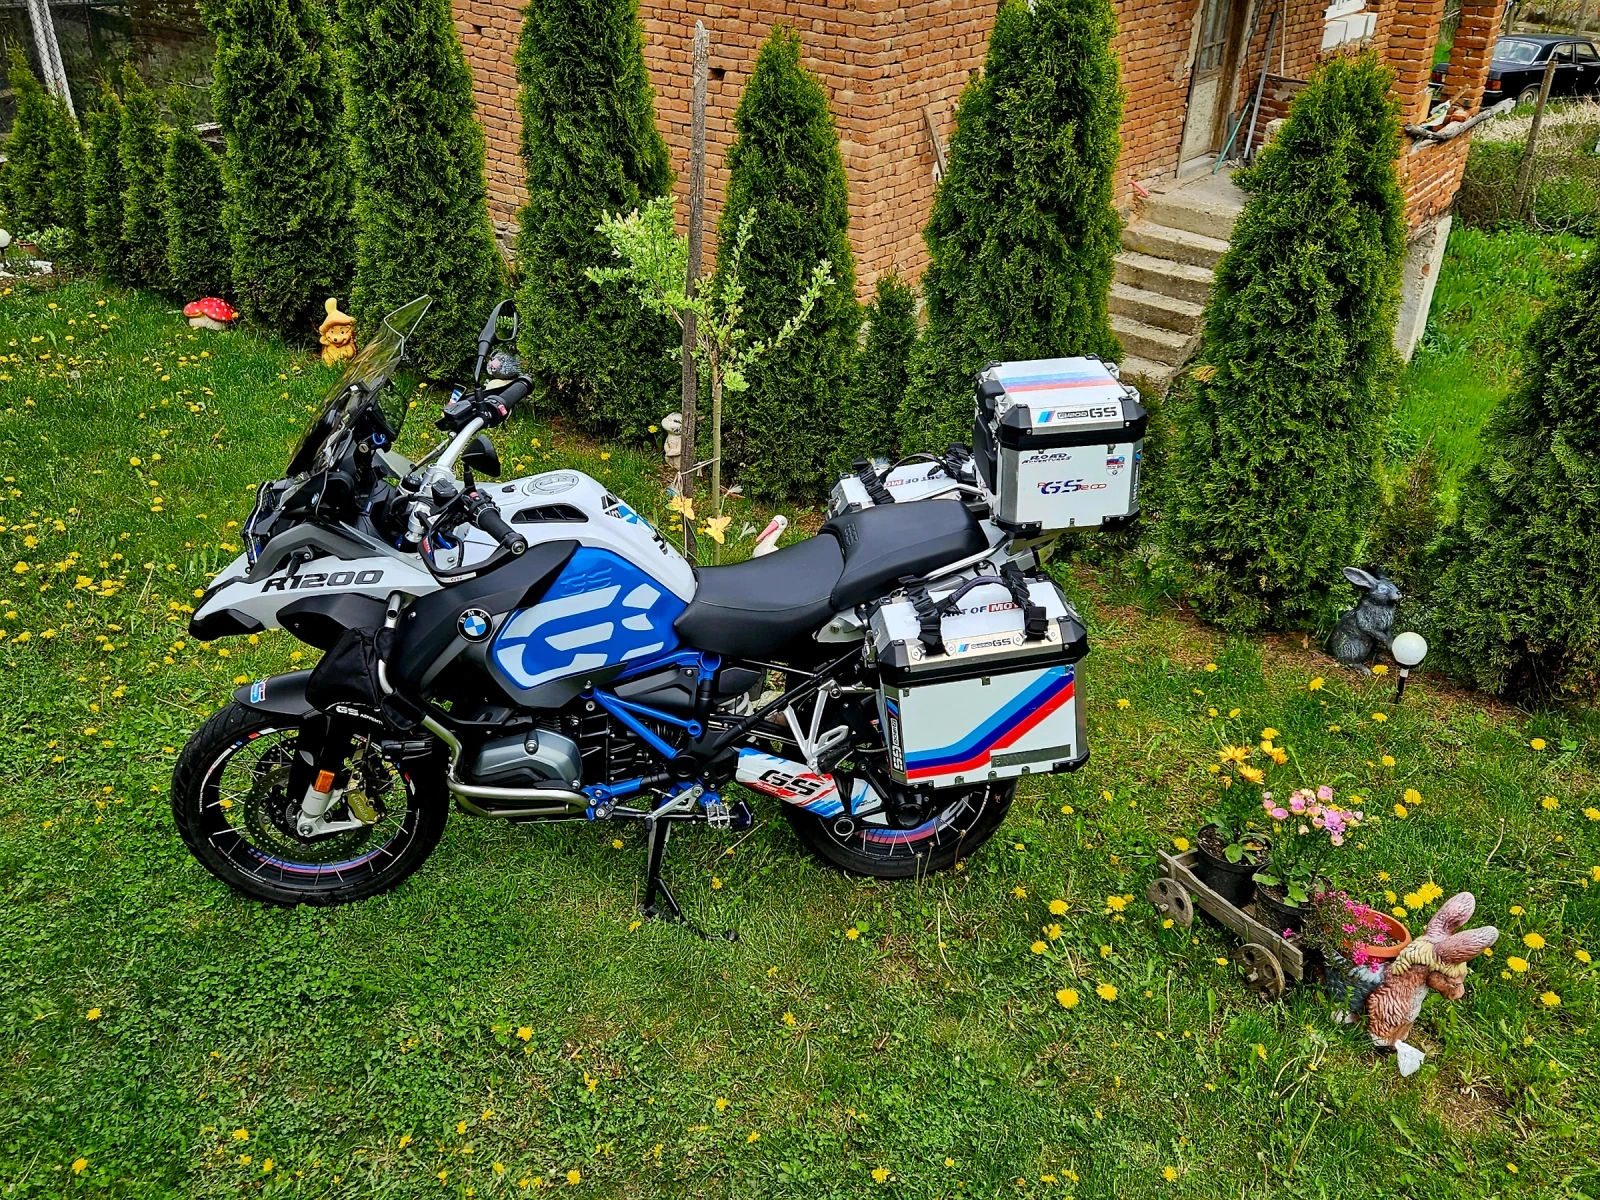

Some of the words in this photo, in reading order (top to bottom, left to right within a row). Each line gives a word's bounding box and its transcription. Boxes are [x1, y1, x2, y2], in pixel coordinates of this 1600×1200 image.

[1089, 406, 1118, 418] GS
[1030, 453, 1068, 461] ROAD
[260, 570, 384, 593] R1200
[560, 567, 612, 597] GS
[970, 605, 988, 614] OF
[459, 610, 487, 624] BMW
[993, 638, 1012, 647] GS
[335, 705, 359, 717] GS
[892, 745, 904, 772] GS
[758, 769, 821, 796] GS
